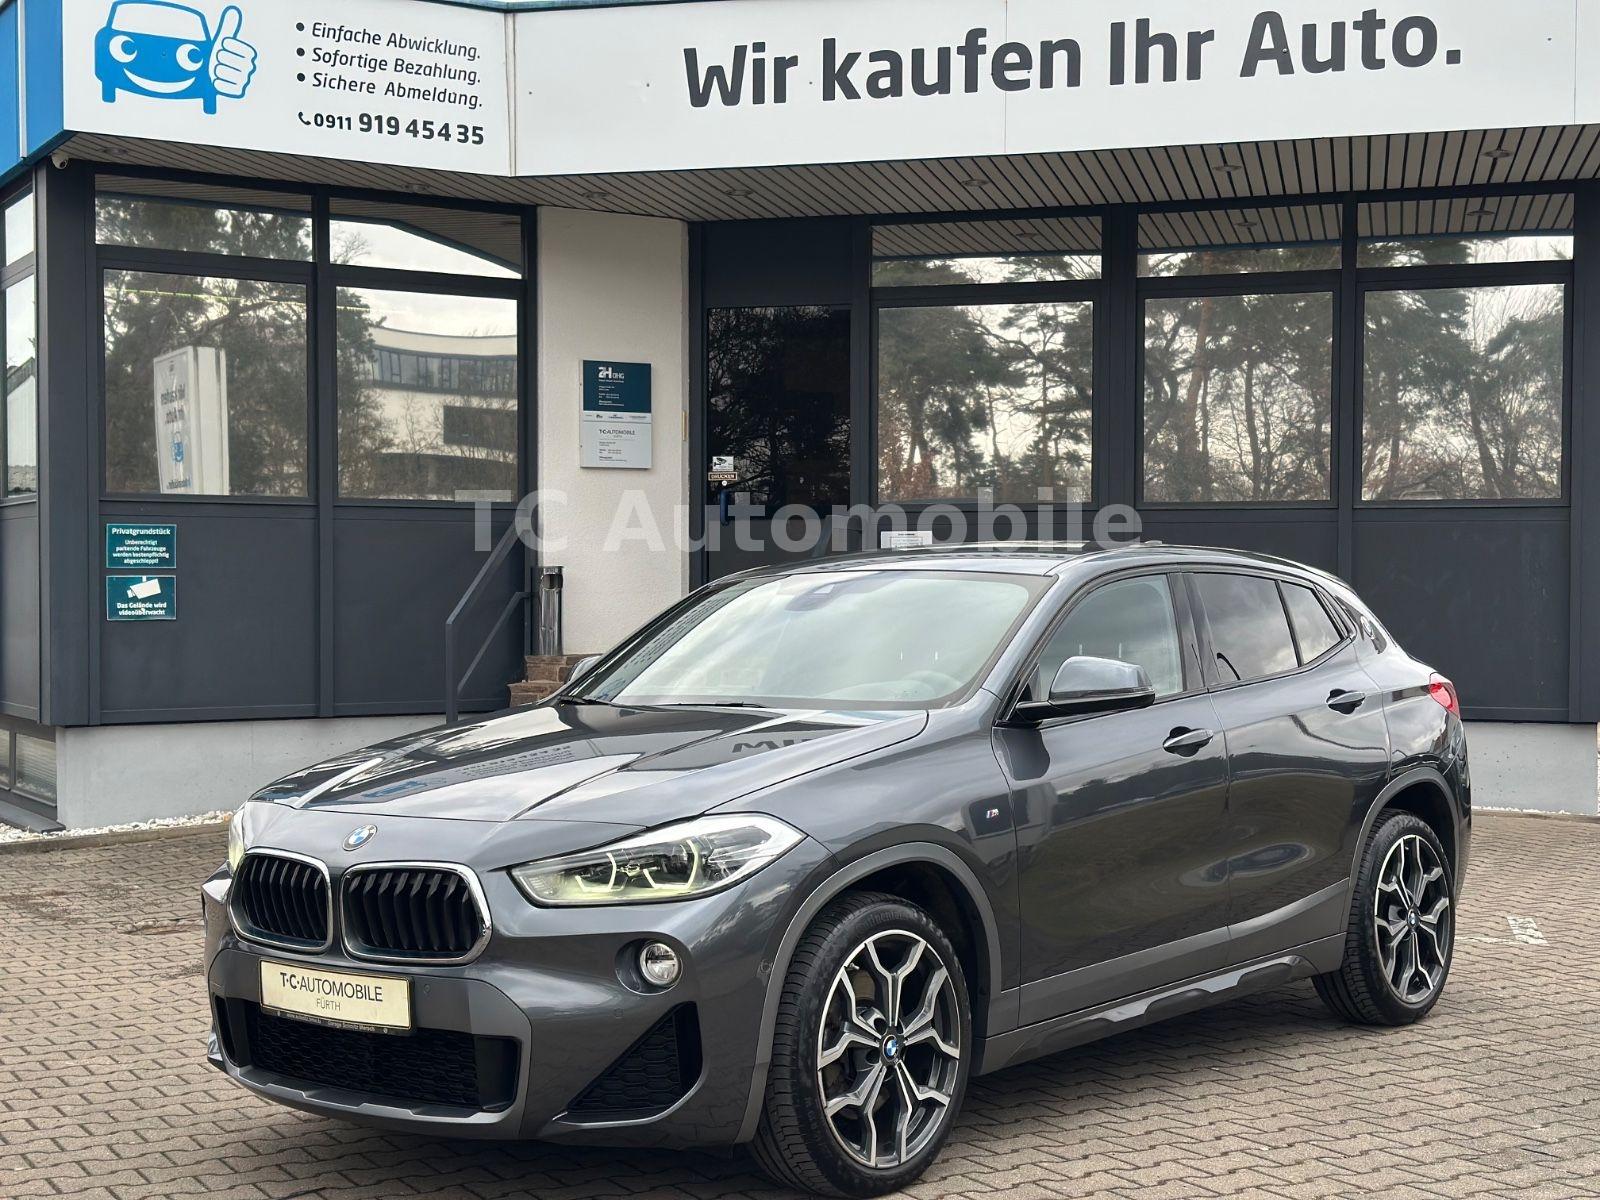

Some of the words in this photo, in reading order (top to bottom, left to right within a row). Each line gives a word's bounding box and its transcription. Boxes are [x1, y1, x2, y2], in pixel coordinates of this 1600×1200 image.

[312, 22, 382, 45] Einfache
[386, 32, 481, 62] Abwicklung.
[312, 47, 388, 73] Sofortige
[394, 58, 481, 86] Bezahlung.
[683, 41, 799, 108] Wir
[822, 27, 1081, 102] kaufen
[1109, 17, 1215, 86] Ihr
[1239, 8, 1462, 78] Auto.
[312, 72, 376, 94] Sichere
[384, 81, 483, 110] Abmeldung.
[313, 112, 352, 131] 0911
[358, 112, 400, 136] 919
[111, 527, 171, 536] Privatgrundstück
[118, 608, 166, 616] videoüberwacht
[316, 997, 341, 1012] FÜRTH
